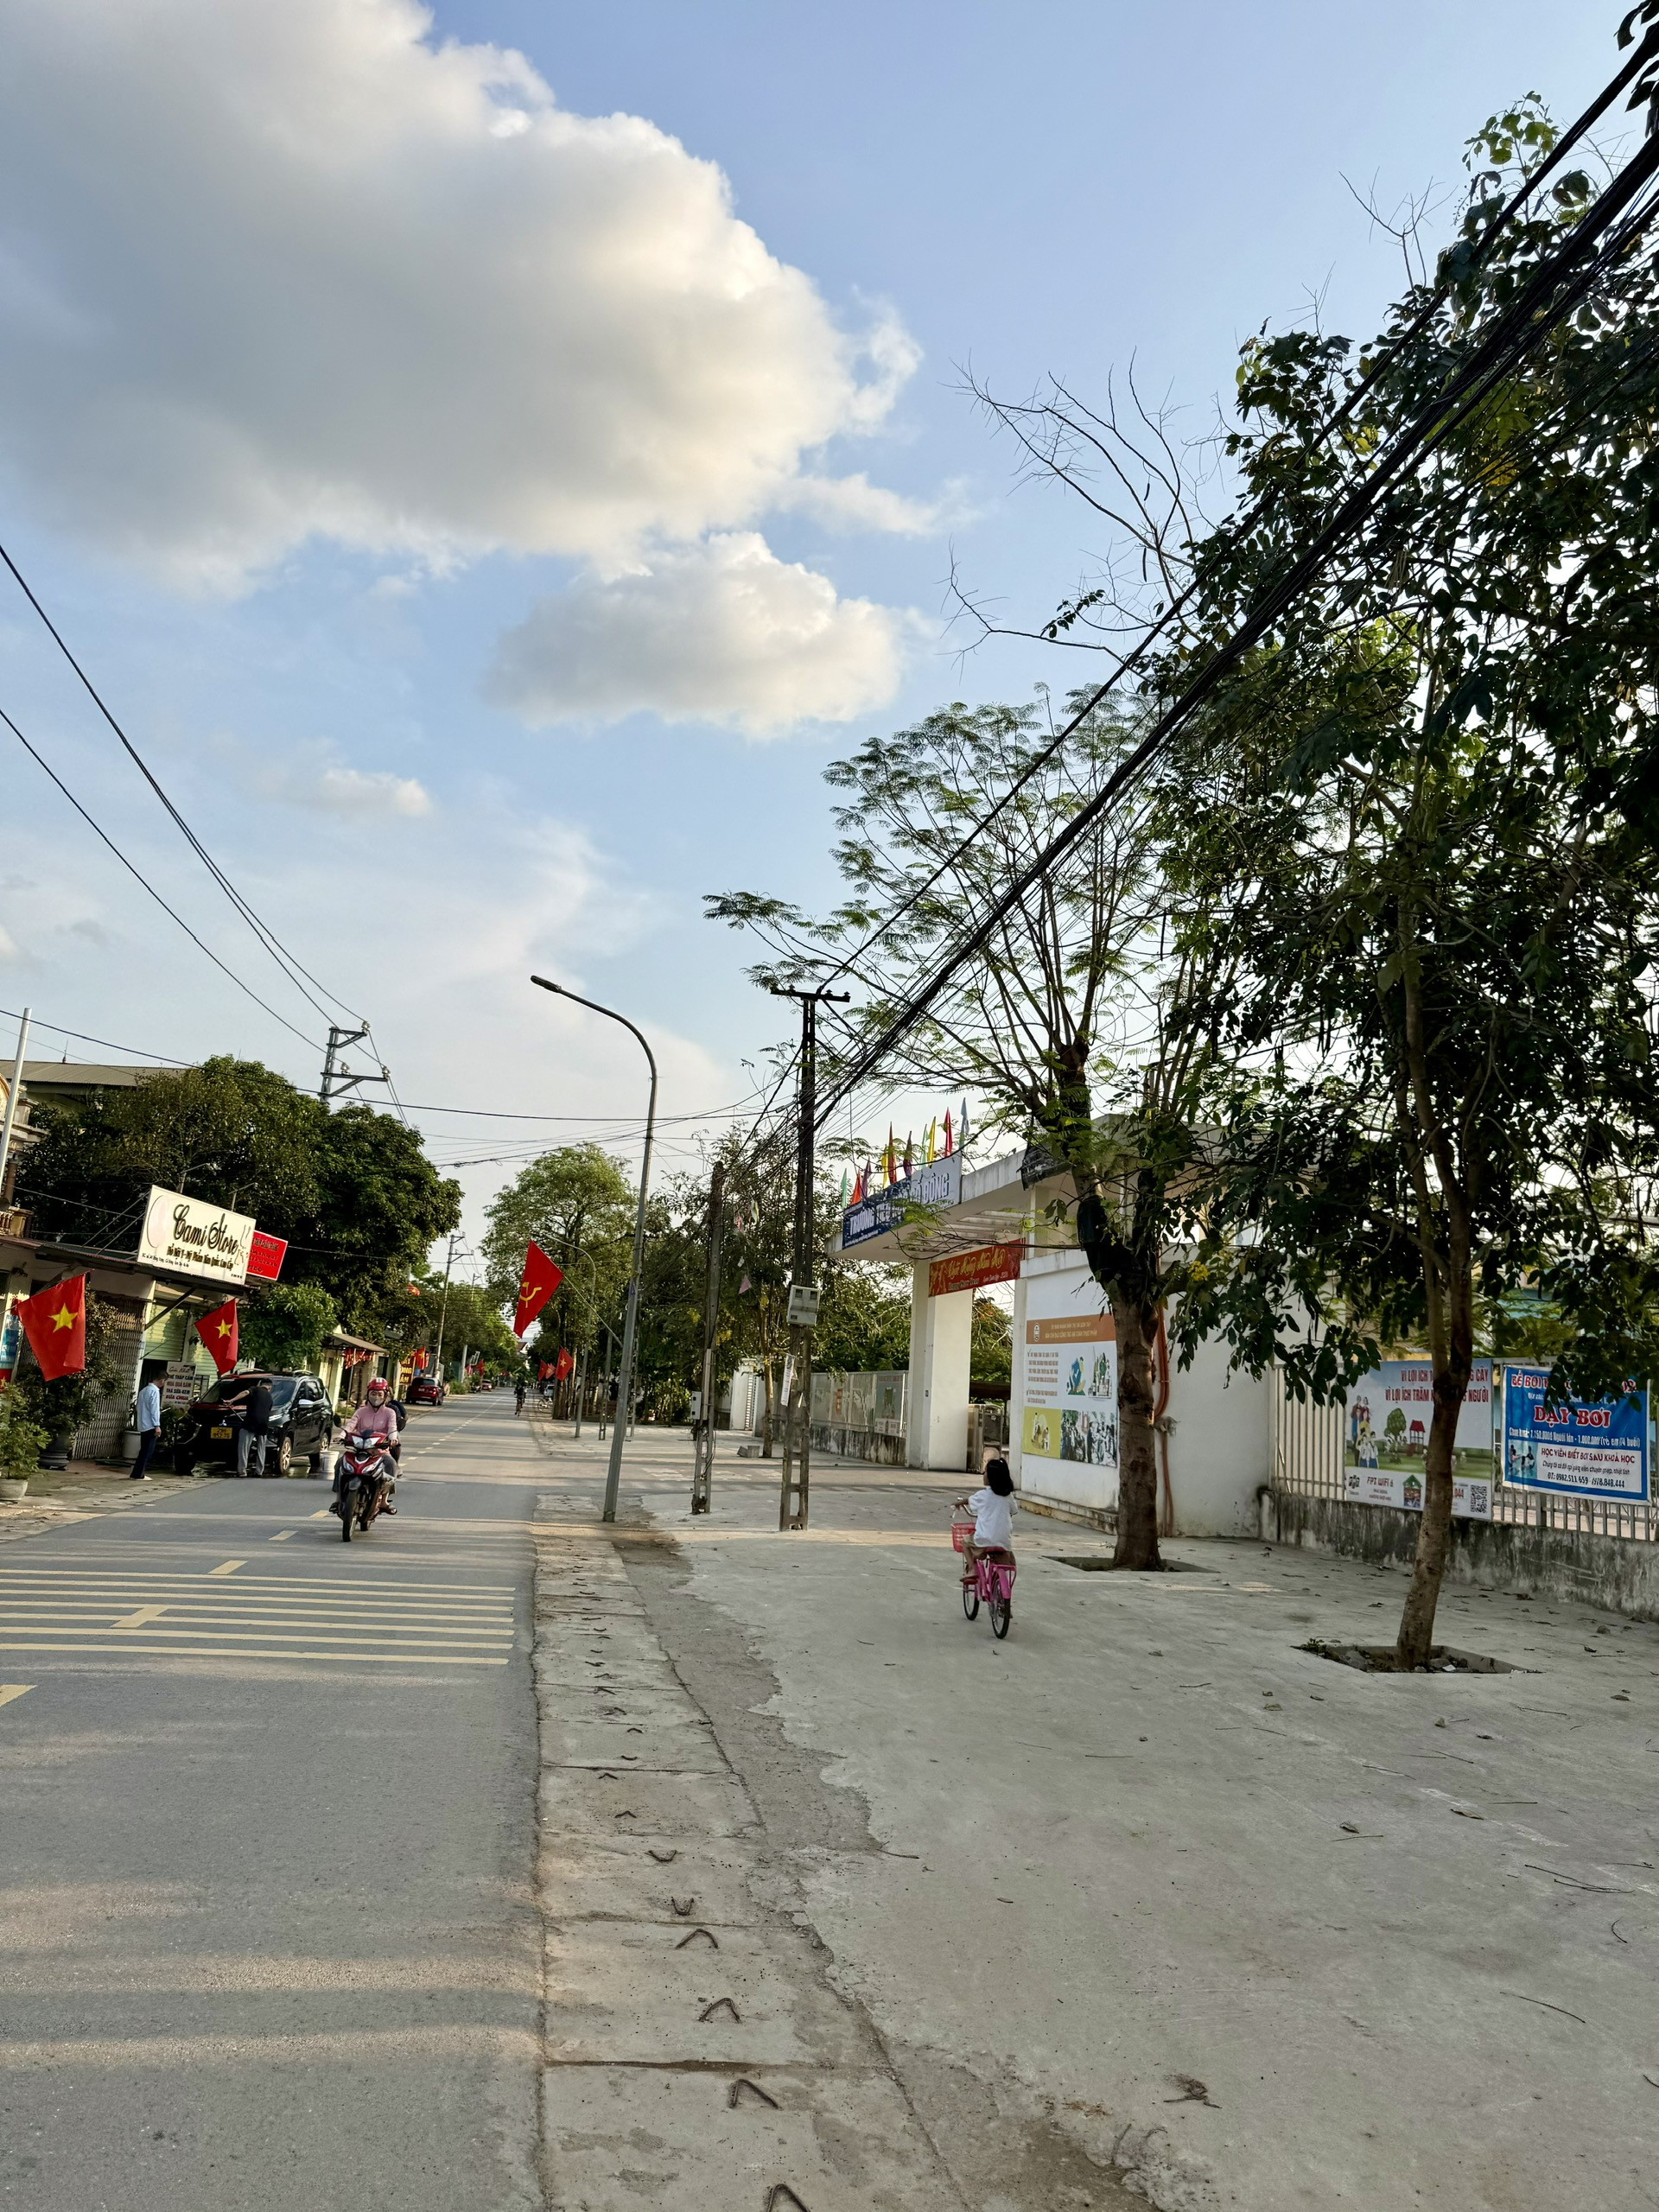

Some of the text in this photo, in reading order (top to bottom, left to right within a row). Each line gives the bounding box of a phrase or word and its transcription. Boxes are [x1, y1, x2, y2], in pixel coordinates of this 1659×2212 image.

[173, 1204, 239, 1255] Cami Store
[1534, 1405, 1611, 1428] DẠY BƠI
[1541, 1447, 1553, 1458] HỌC
[1567, 1447, 1579, 1459] BIẾT
[1620, 1454, 1635, 1465] HỌC
